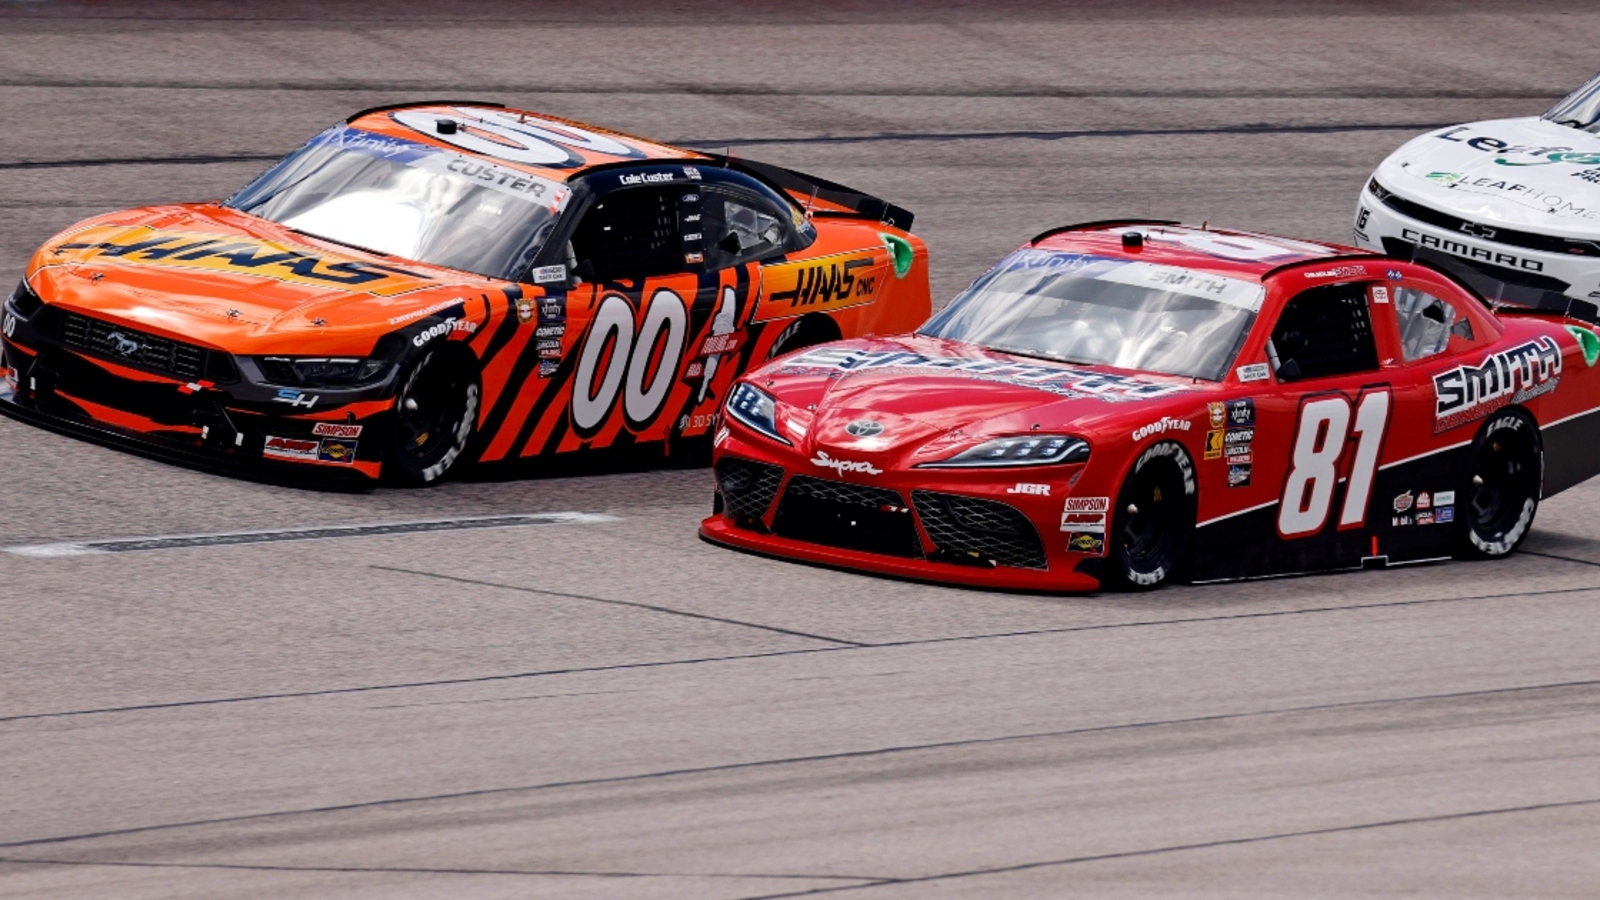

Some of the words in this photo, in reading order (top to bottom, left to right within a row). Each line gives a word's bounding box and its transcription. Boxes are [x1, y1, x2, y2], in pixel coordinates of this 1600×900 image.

[446, 160, 547, 198] CUSTER
[619, 174, 642, 185] Cole
[641, 172, 674, 183] Custer
[60, 236, 433, 285] HAAS
[1402, 228, 1544, 272] CAMARO
[769, 257, 875, 307] HAAS
[856, 277, 875, 296] CNC
[1148, 270, 1228, 294] SMITH
[412, 317, 477, 347] GOODYEAR
[573, 290, 687, 429] 00
[1432, 335, 1562, 418] SMITH
[315, 424, 361, 437] SIMPSON
[1132, 416, 1192, 442] GOODYEAR
[1486, 416, 1524, 438] EAGLE
[811, 450, 883, 477] Supra
[1277, 391, 1389, 535] 81
[1007, 482, 1051, 497] JGR
[1066, 499, 1109, 512] SIMPSON
